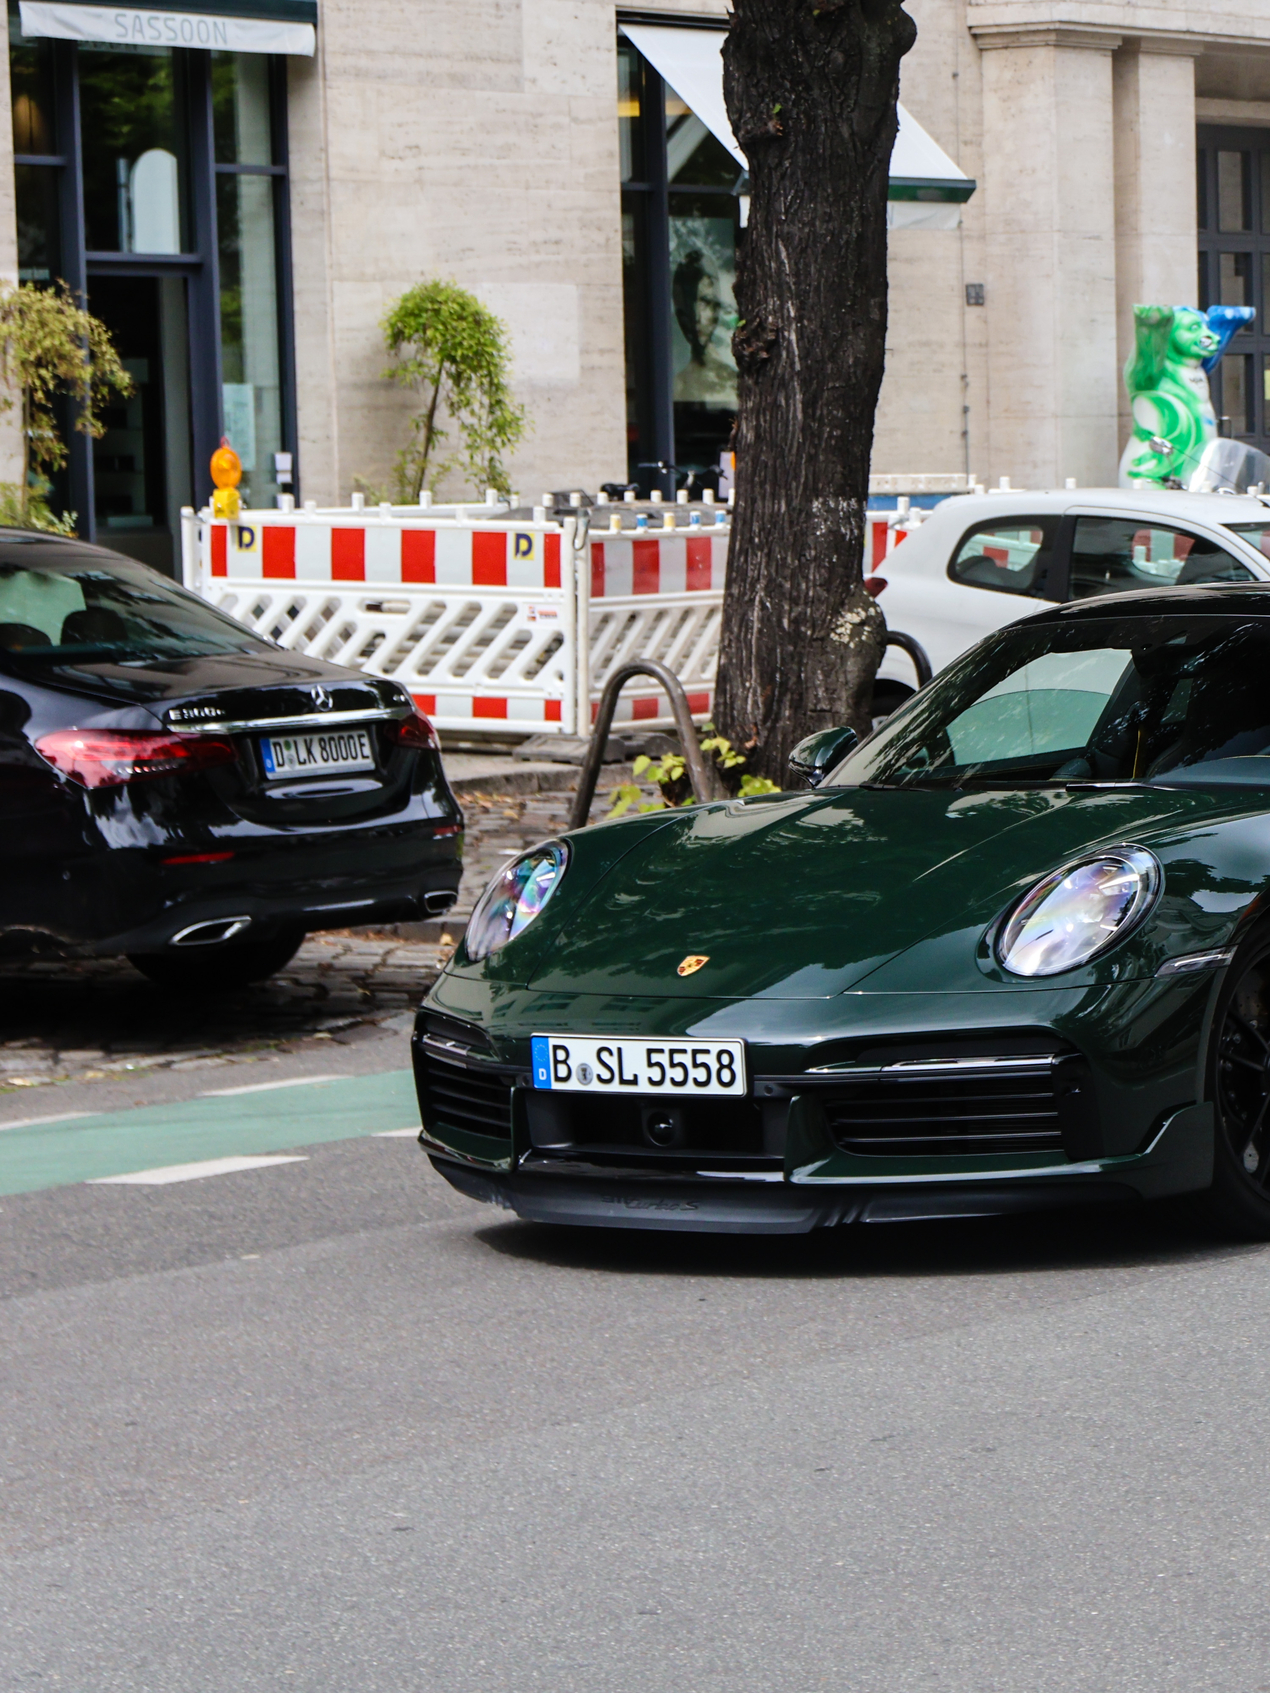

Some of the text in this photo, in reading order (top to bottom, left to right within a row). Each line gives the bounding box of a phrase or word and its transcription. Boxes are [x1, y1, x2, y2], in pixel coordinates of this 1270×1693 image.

[113, 13, 228, 45] SASSOON
[236, 526, 255, 549] D
[515, 533, 533, 558] D
[272, 742, 285, 767] D
[293, 737, 317, 766] LK
[318, 733, 370, 763] 8000E
[552, 1045, 572, 1082] B
[596, 1046, 638, 1086] SL
[647, 1048, 736, 1087] 5558
